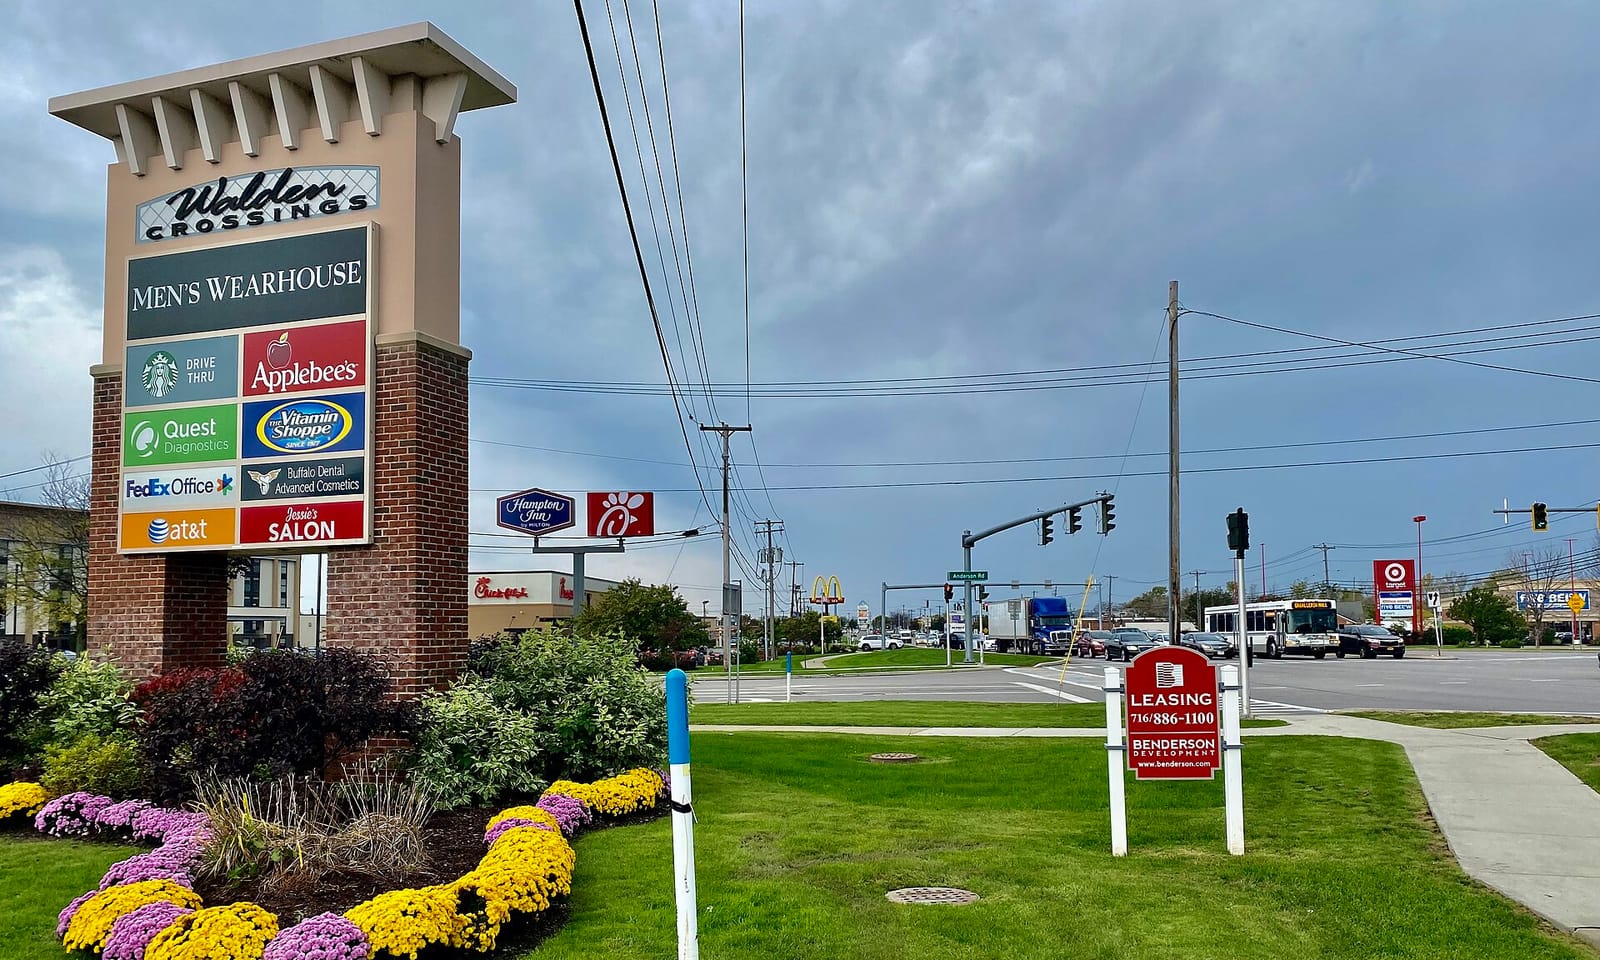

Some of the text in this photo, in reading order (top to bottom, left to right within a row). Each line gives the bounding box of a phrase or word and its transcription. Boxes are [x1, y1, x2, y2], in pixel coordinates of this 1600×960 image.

[166, 167, 346, 221] Walden
[146, 194, 368, 241] CROSSINGS
[132, 260, 361, 311] MEN'S WEARHOUSE
[186, 356, 216, 370] DRIVE
[187, 371, 215, 384] THRU
[251, 360, 357, 393] Applebee's
[281, 410, 338, 426] Vitamin
[164, 418, 216, 439] Quest
[272, 424, 332, 439] Shoppe
[165, 439, 229, 455] Diagnostics
[287, 464, 345, 480] Buffalo Dental
[126, 478, 214, 498] FedEx Office
[275, 478, 360, 495] Advanced Cosmetics
[506, 498, 565, 512] Hampton
[286, 507, 318, 522] Jessie's
[520, 510, 551, 522] Inn
[170, 519, 208, 540] at&t
[268, 520, 335, 542] SALON
[1131, 693, 1212, 707] LEASING
[1130, 712, 1214, 725] 716/886-1100
[1133, 739, 1215, 750] BENDERSON
[1138, 760, 1211, 768] www.benderson.com
